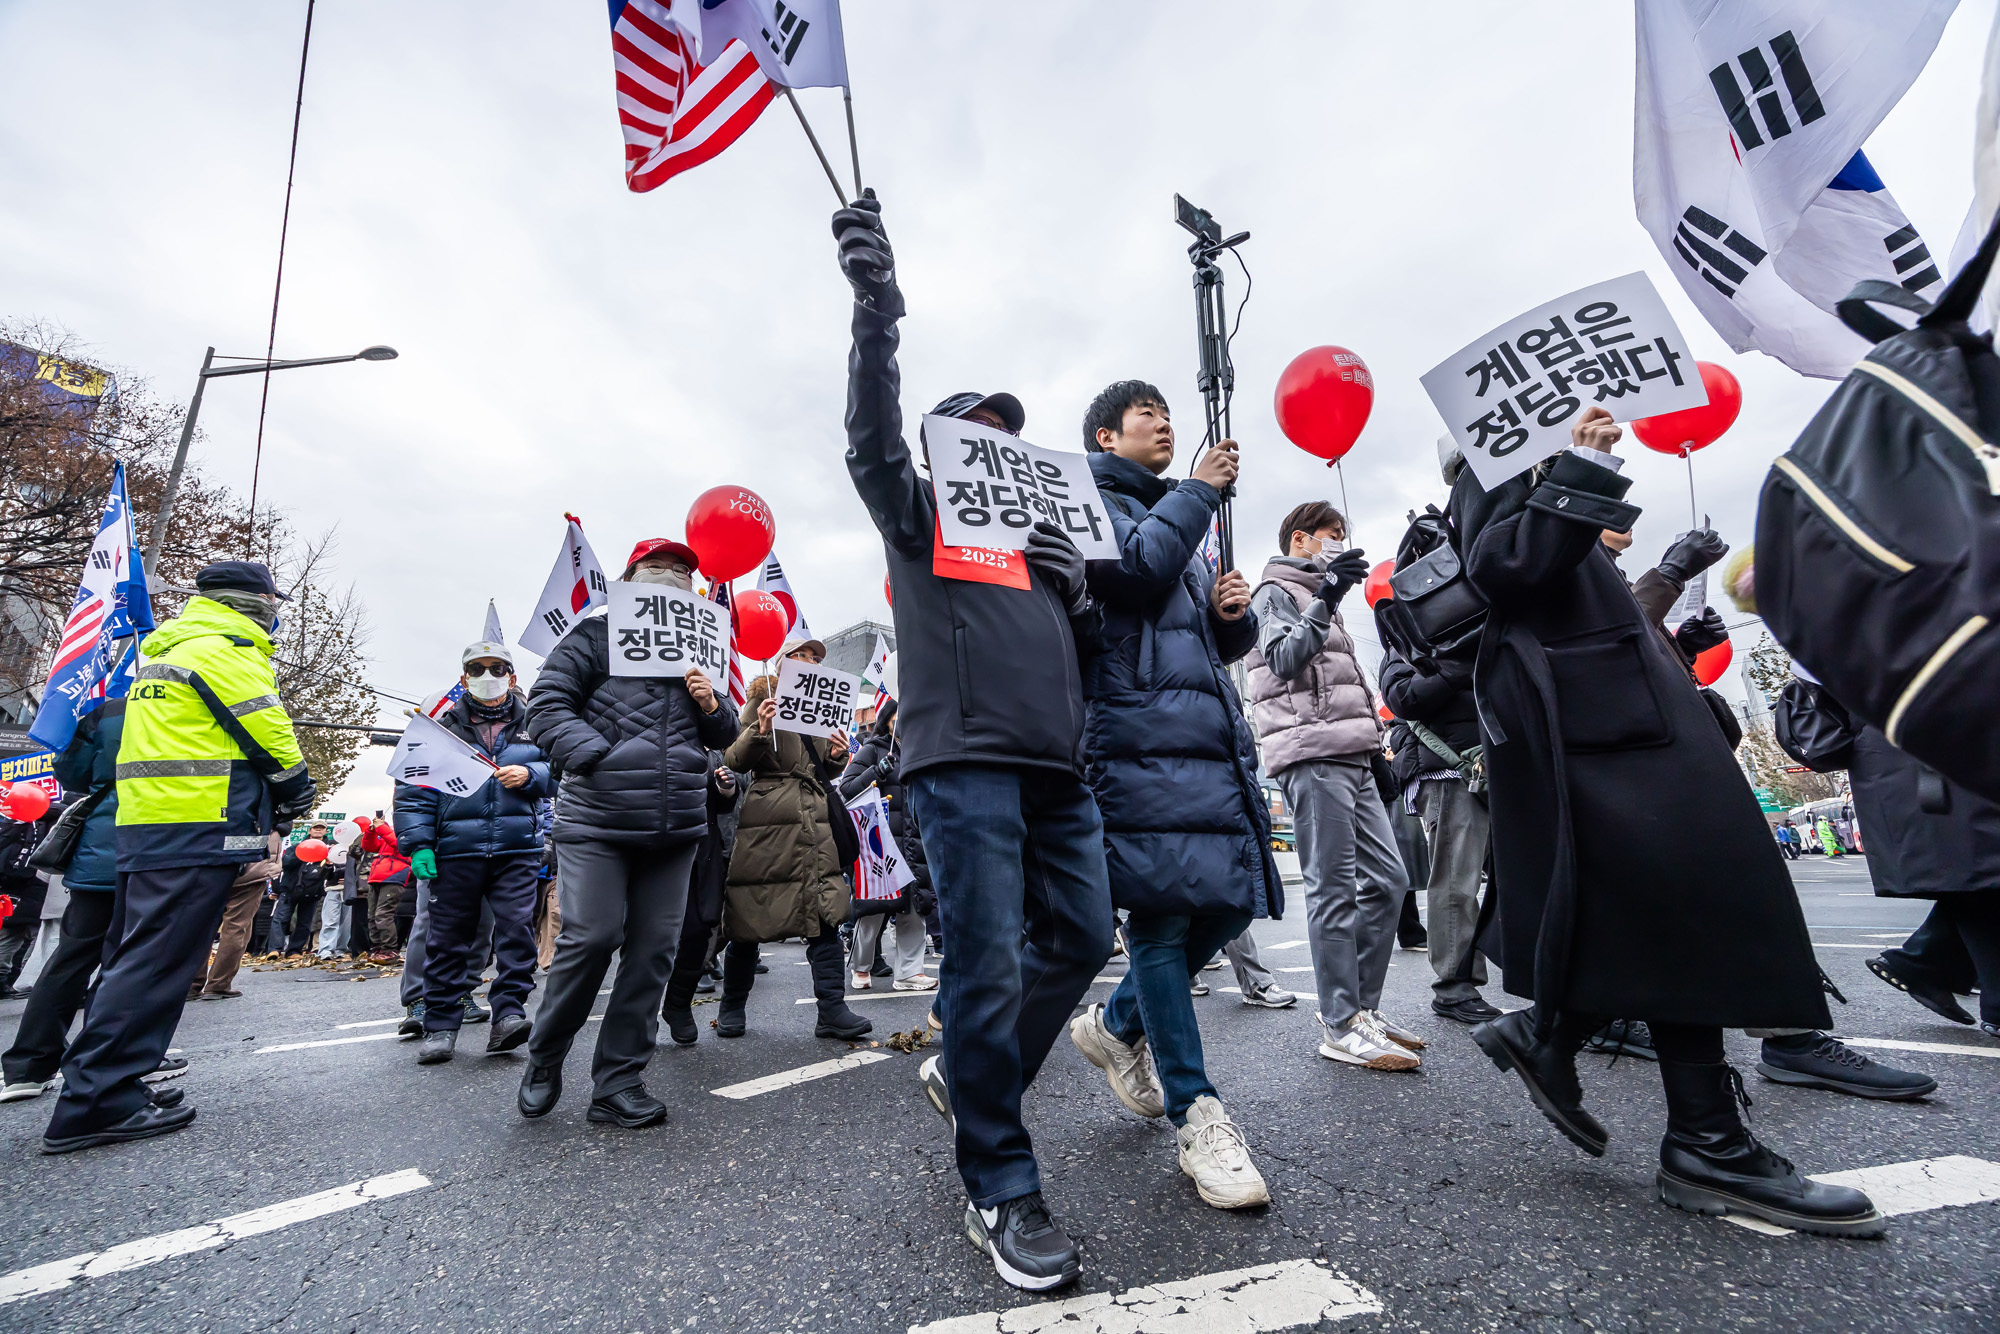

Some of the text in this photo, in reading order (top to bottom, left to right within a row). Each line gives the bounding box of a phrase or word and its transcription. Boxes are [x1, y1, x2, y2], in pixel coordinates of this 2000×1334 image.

[1465, 301, 1636, 397] 계엄은
[1465, 336, 1685, 458] 정당했다
[960, 438, 1070, 500] 계엄은
[729, 498, 771, 531] YOON
[738, 491, 769, 516] FREE
[946, 480, 1103, 541] 정당했다
[961, 547, 1008, 569] 2025
[634, 595, 719, 641] 계엄은
[617, 628, 727, 679] 정당했다
[129, 684, 167, 701] ICE
[793, 673, 851, 705] 계엄은
[778, 695, 853, 732] 정당했다
